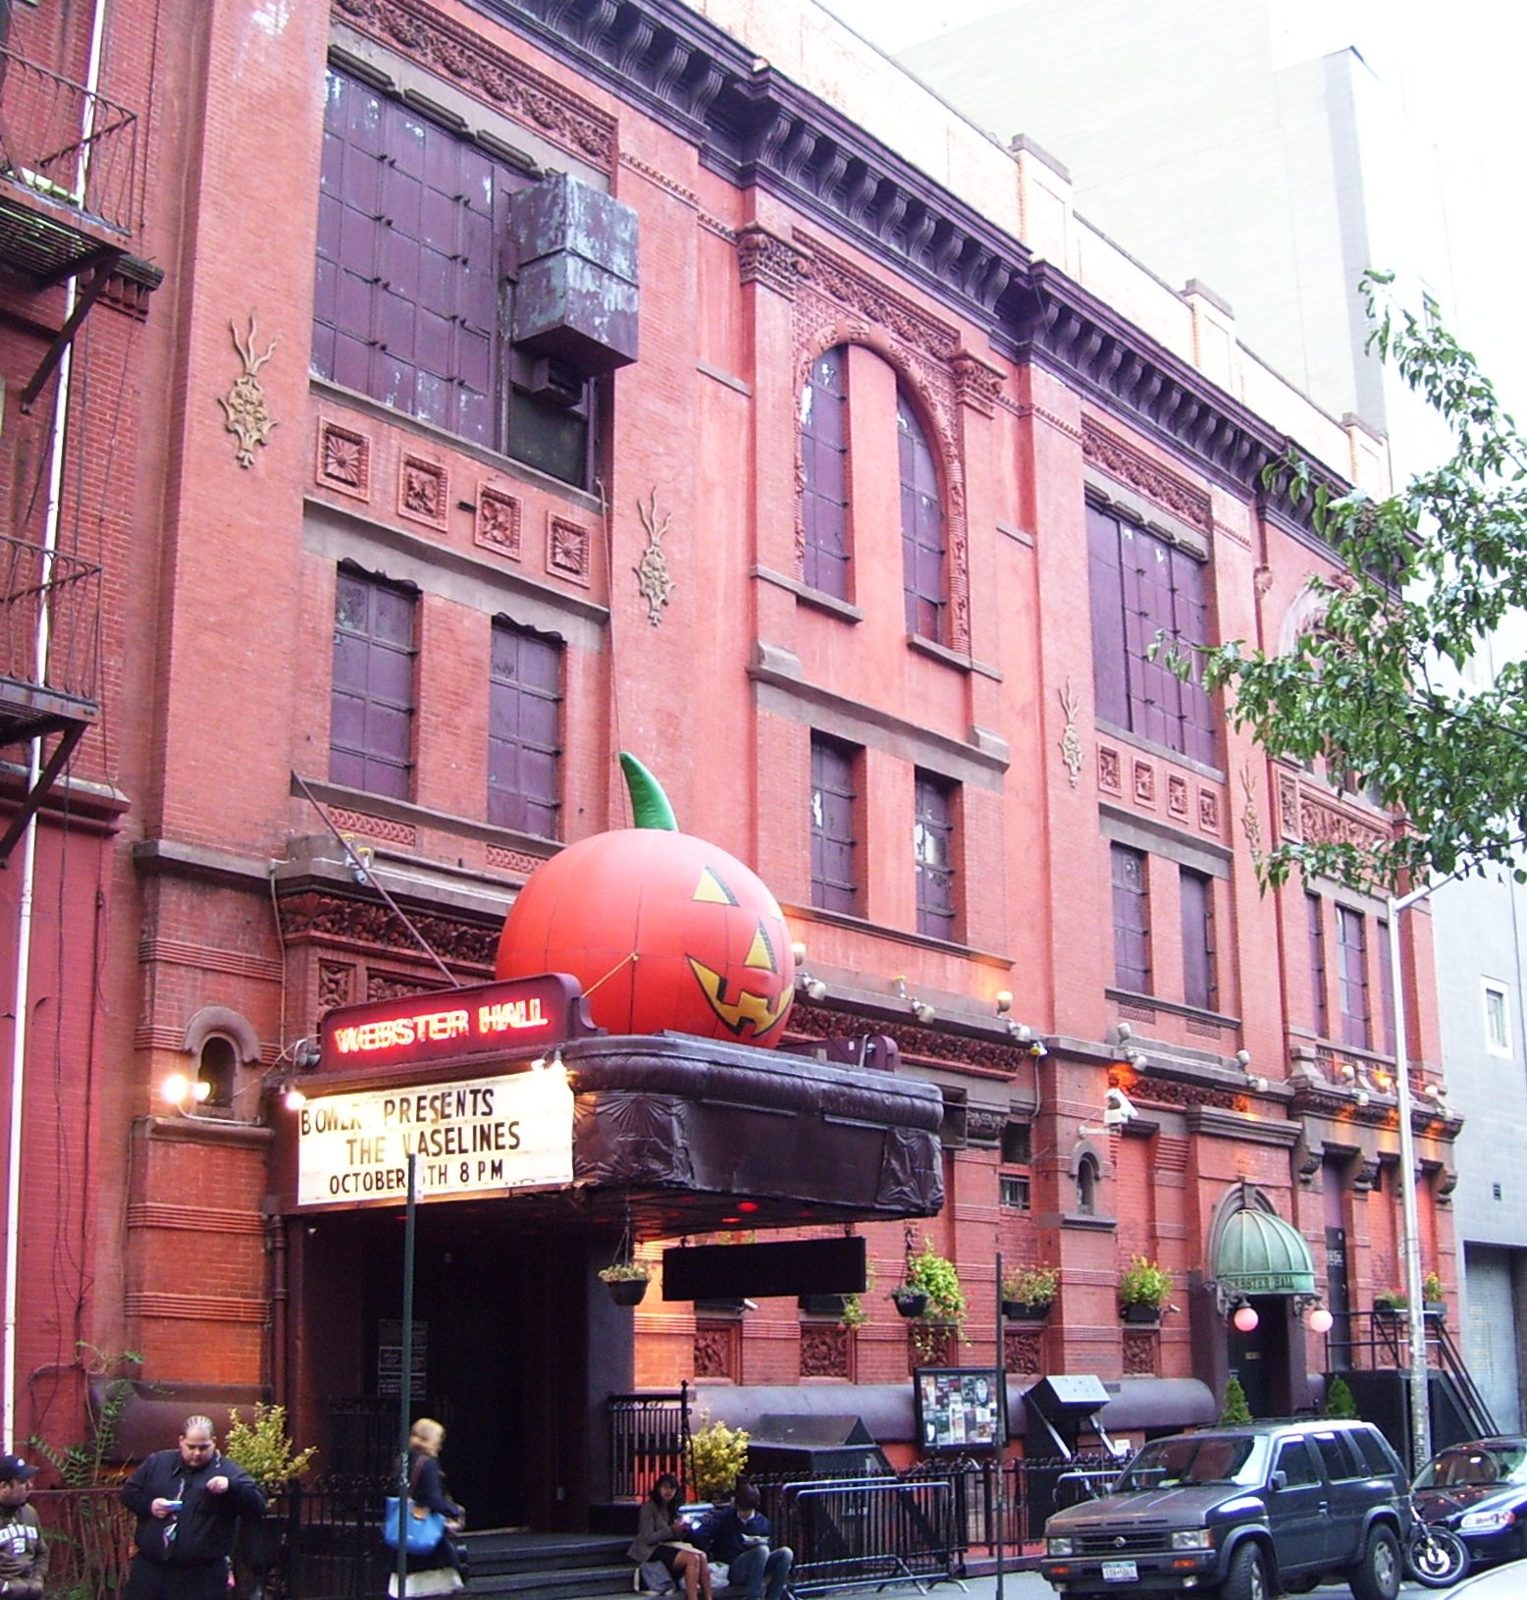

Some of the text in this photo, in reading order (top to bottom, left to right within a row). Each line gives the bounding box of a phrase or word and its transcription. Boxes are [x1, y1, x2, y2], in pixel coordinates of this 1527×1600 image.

[335, 998, 549, 1053] WEBSTER HALL
[384, 1088, 494, 1126] PRESENTS
[346, 1120, 520, 1166] THE VASELINES
[329, 1168, 406, 1195] OCTOBER
[422, 1164, 448, 1186] TH
[459, 1161, 469, 1183] 8
